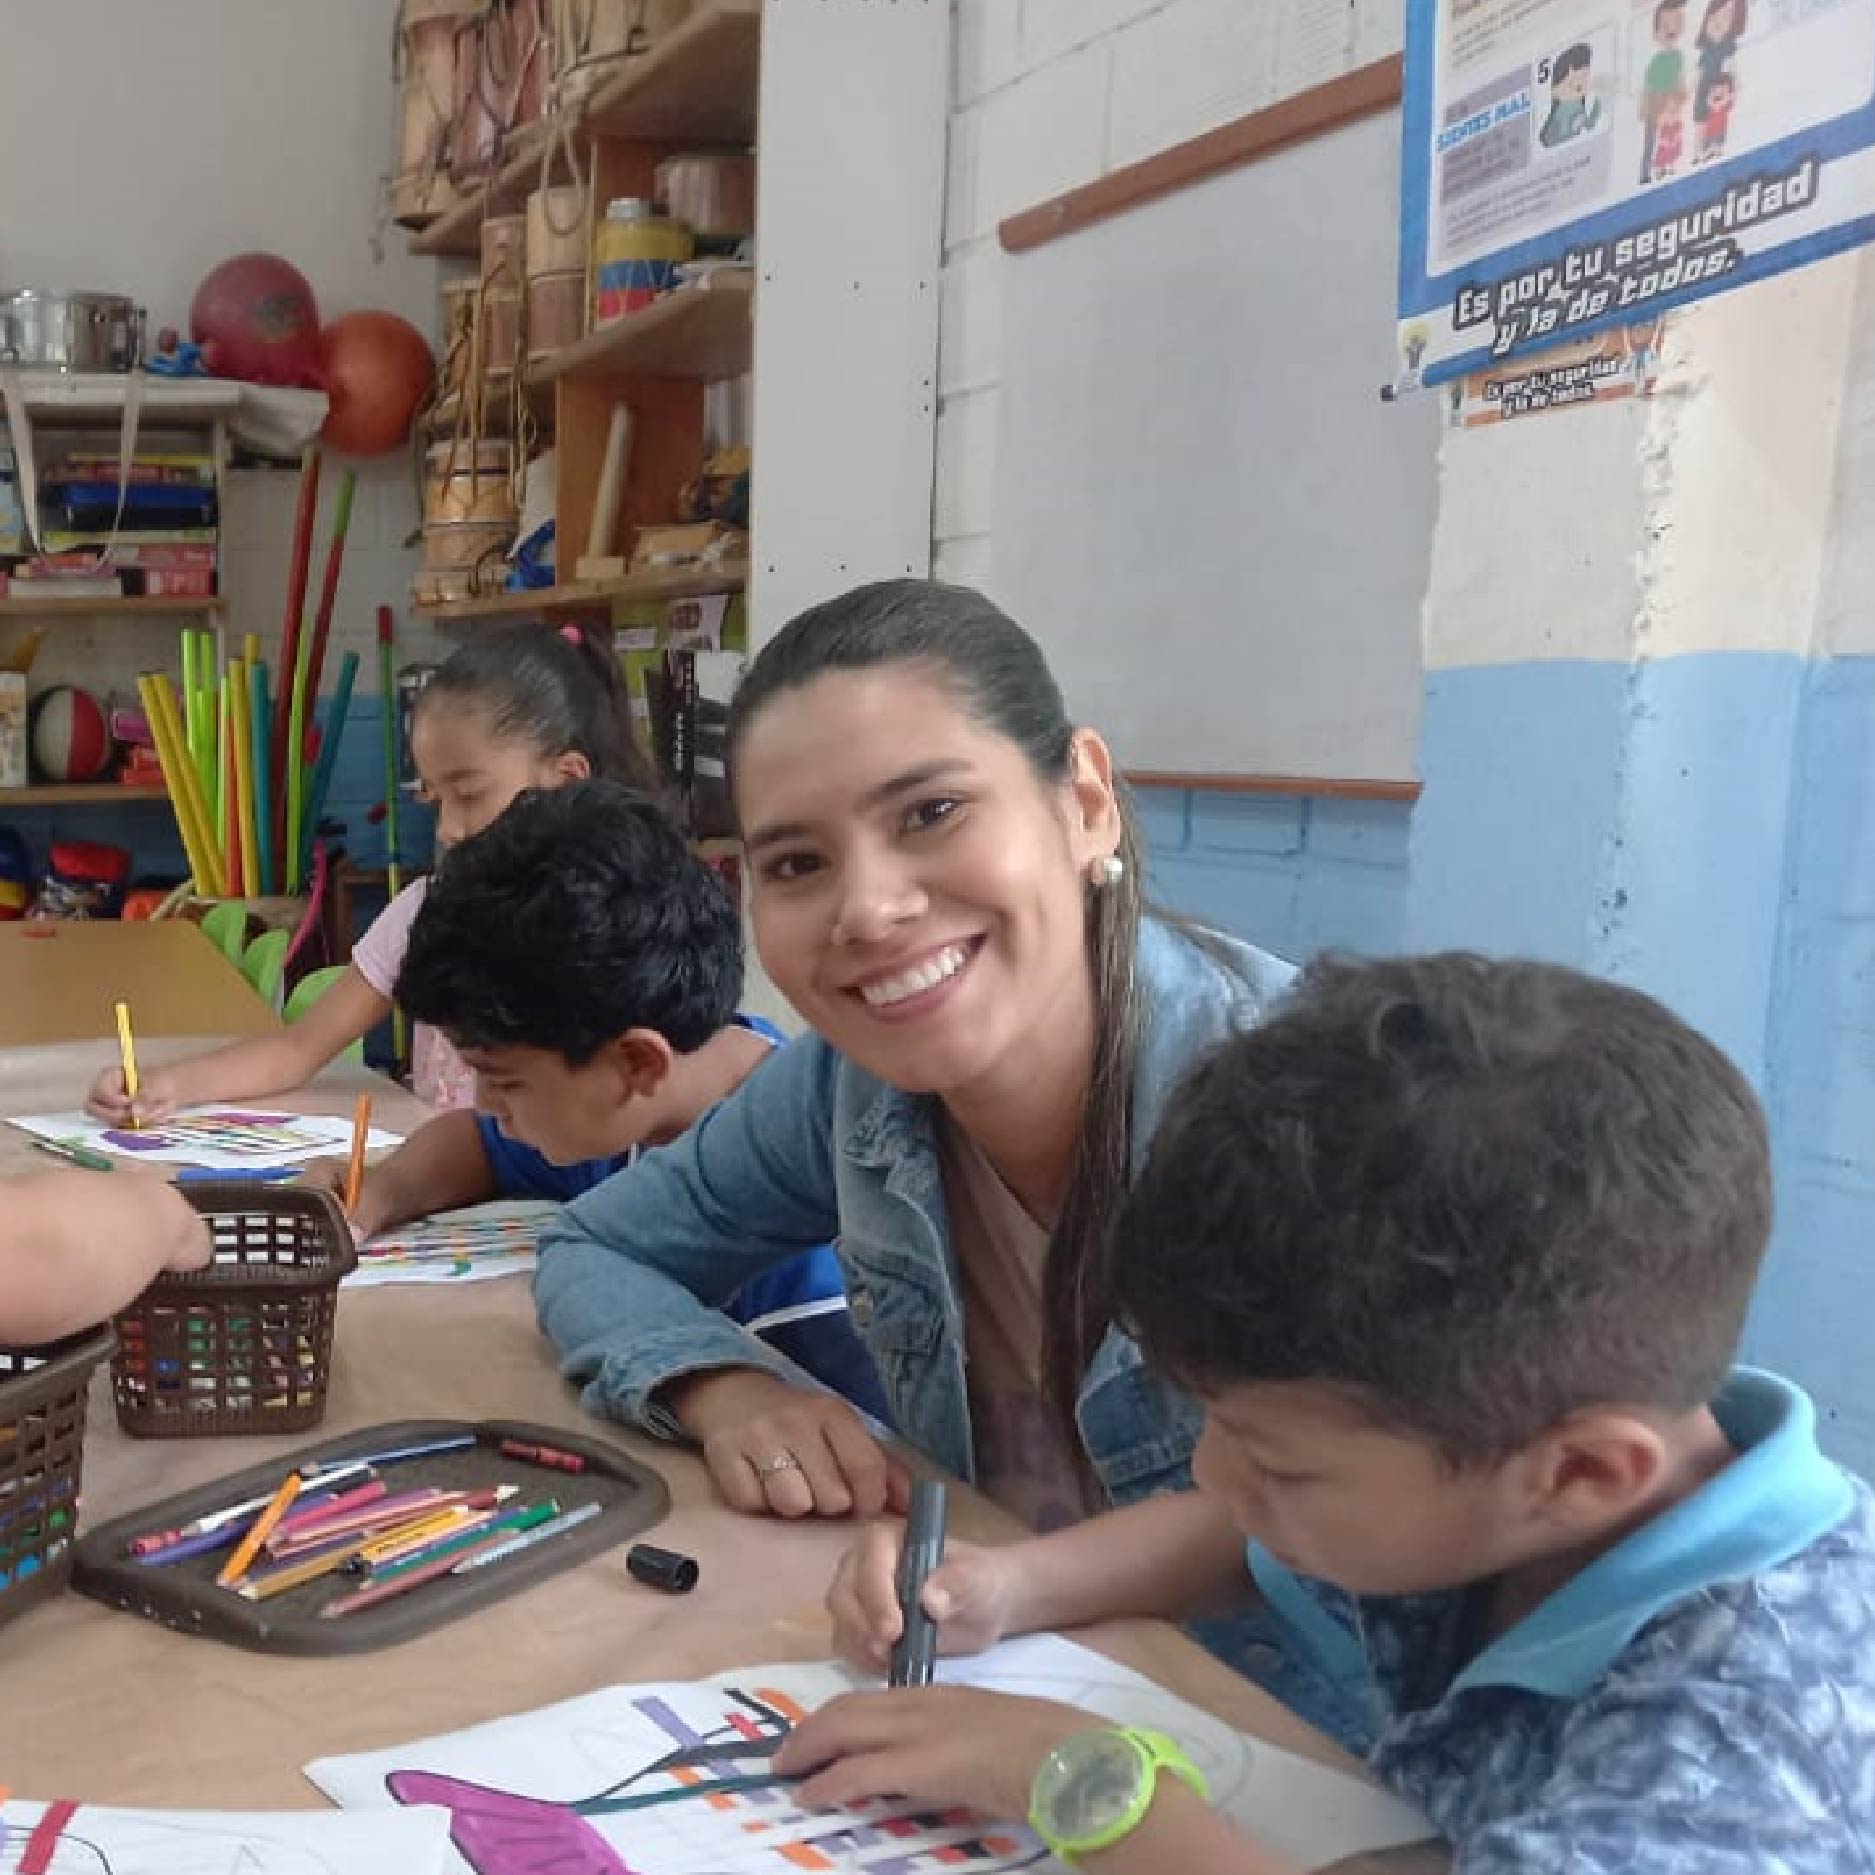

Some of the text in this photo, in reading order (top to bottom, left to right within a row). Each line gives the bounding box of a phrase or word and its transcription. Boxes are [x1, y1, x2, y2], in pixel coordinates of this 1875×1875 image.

[1537, 58, 1549, 84] 5
[1458, 289, 1489, 323] Es
[1498, 266, 1554, 318] por
[1564, 247, 1604, 284] tu
[1614, 161, 1813, 266] seguridad
[1492, 247, 1737, 354] y la de todos.
